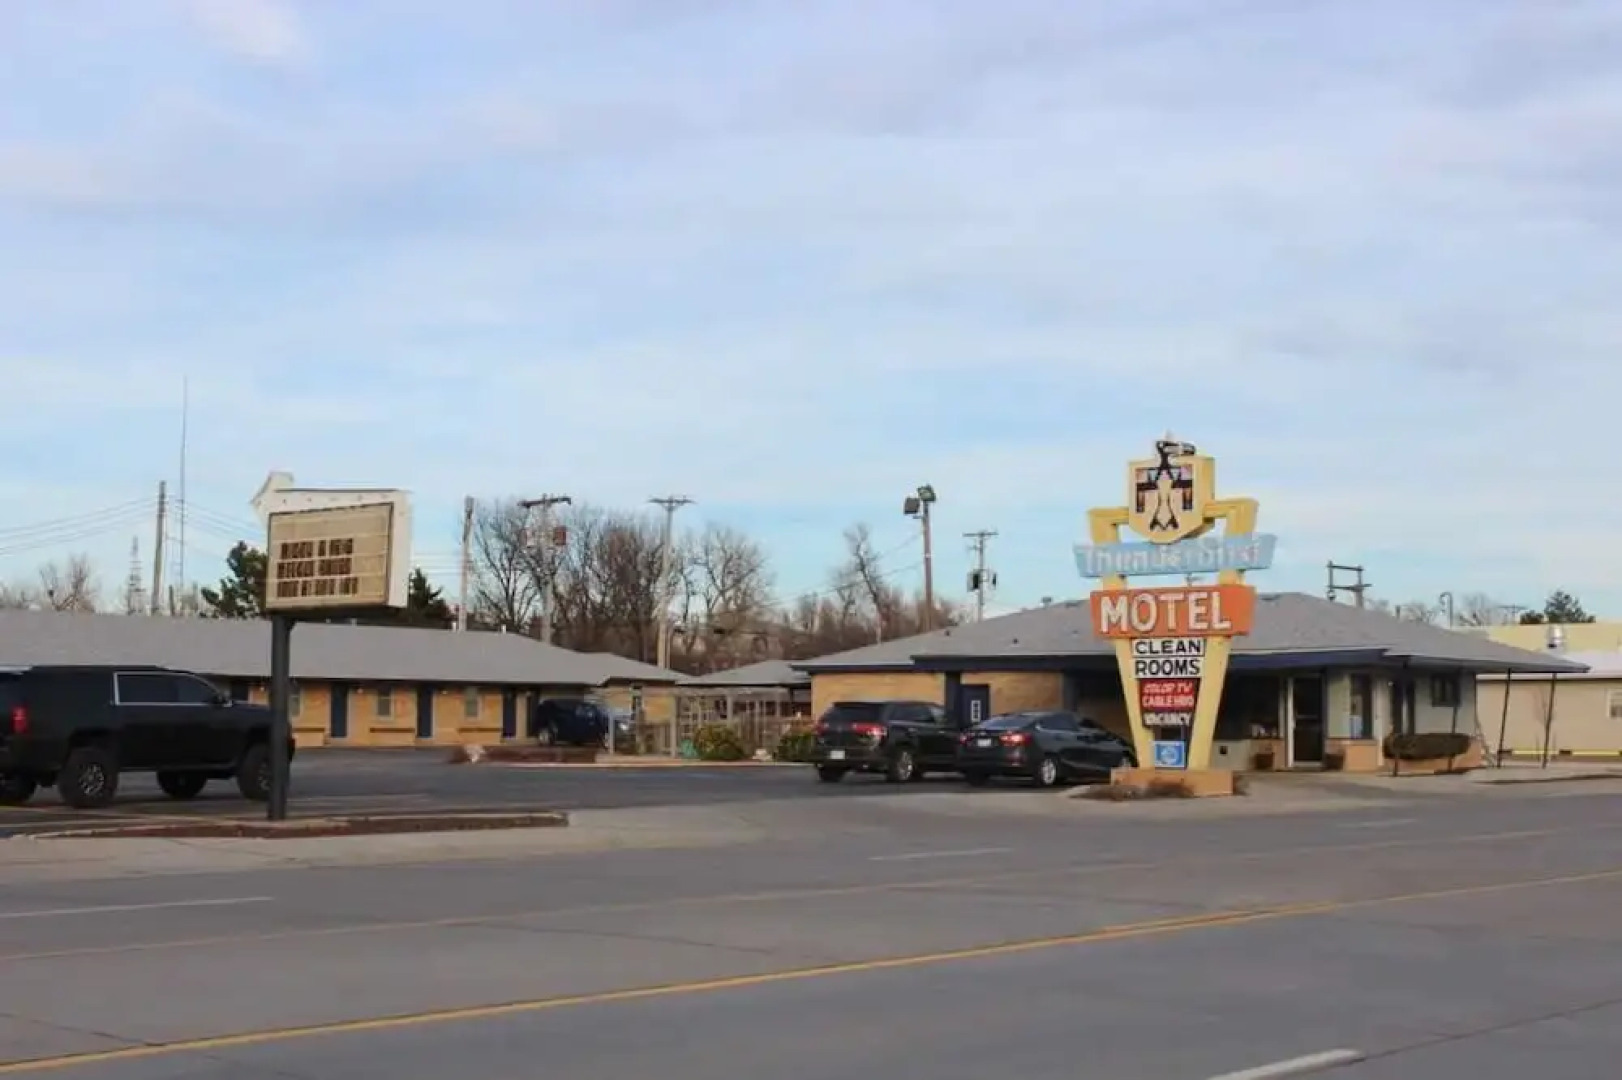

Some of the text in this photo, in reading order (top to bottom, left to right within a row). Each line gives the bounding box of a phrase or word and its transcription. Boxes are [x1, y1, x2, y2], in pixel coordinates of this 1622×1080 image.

[1101, 591, 1232, 634] MOTEL
[1135, 639, 1201, 655] CLEAN
[1135, 659, 1201, 676] ROOMS
